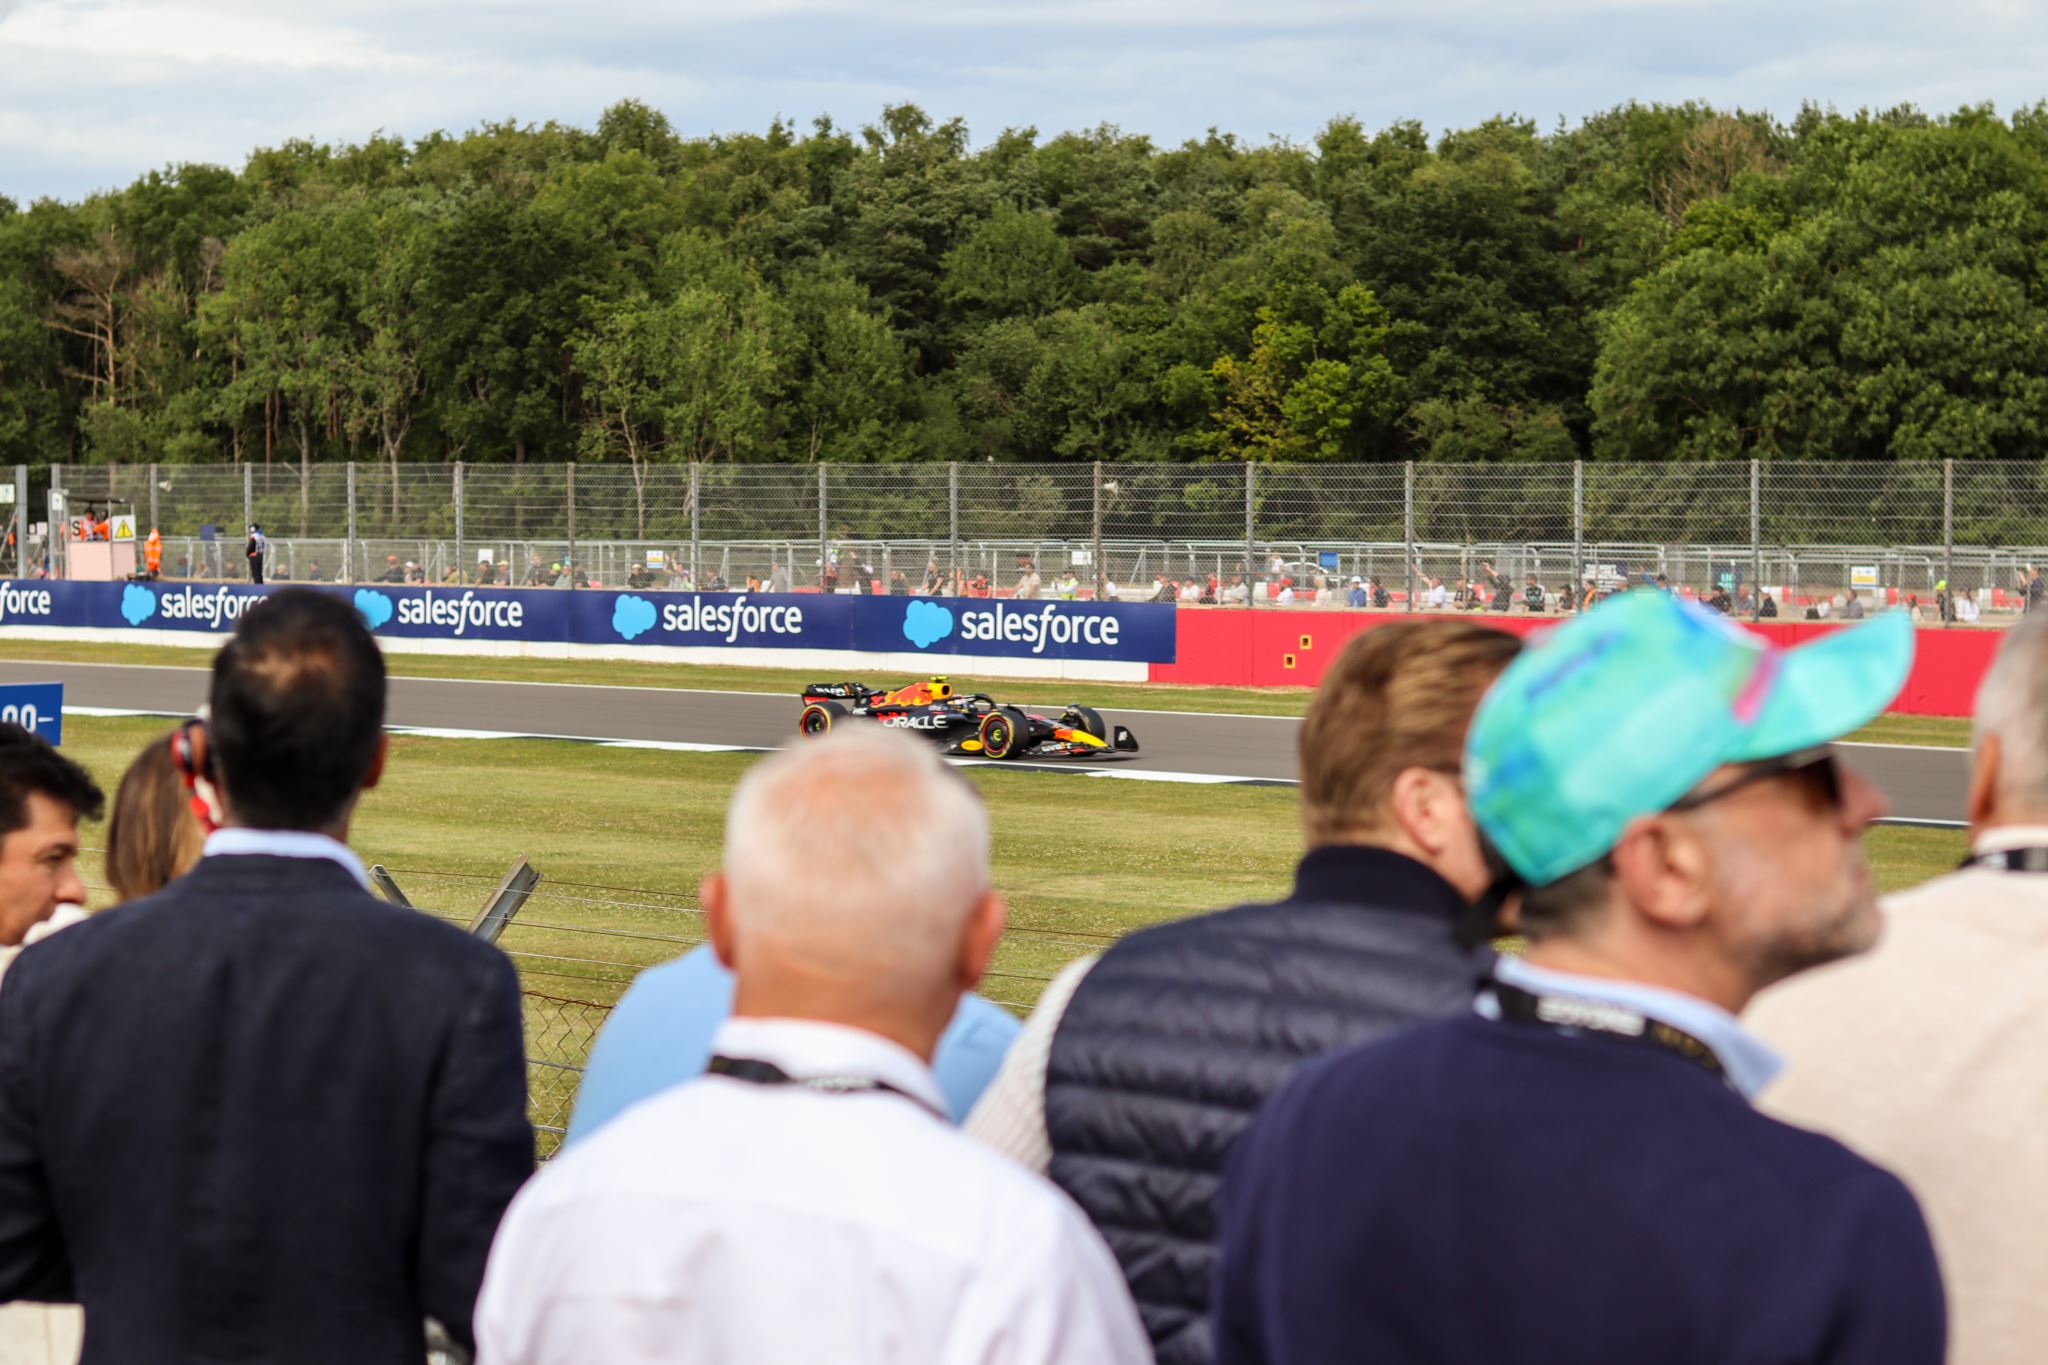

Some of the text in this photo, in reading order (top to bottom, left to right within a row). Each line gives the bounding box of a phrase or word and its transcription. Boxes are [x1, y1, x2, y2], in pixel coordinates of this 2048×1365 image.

[398, 590, 523, 635] salesforce
[663, 595, 803, 643] salesforce
[961, 603, 1120, 653] salesforce
[883, 714, 949, 729] ORACLE
